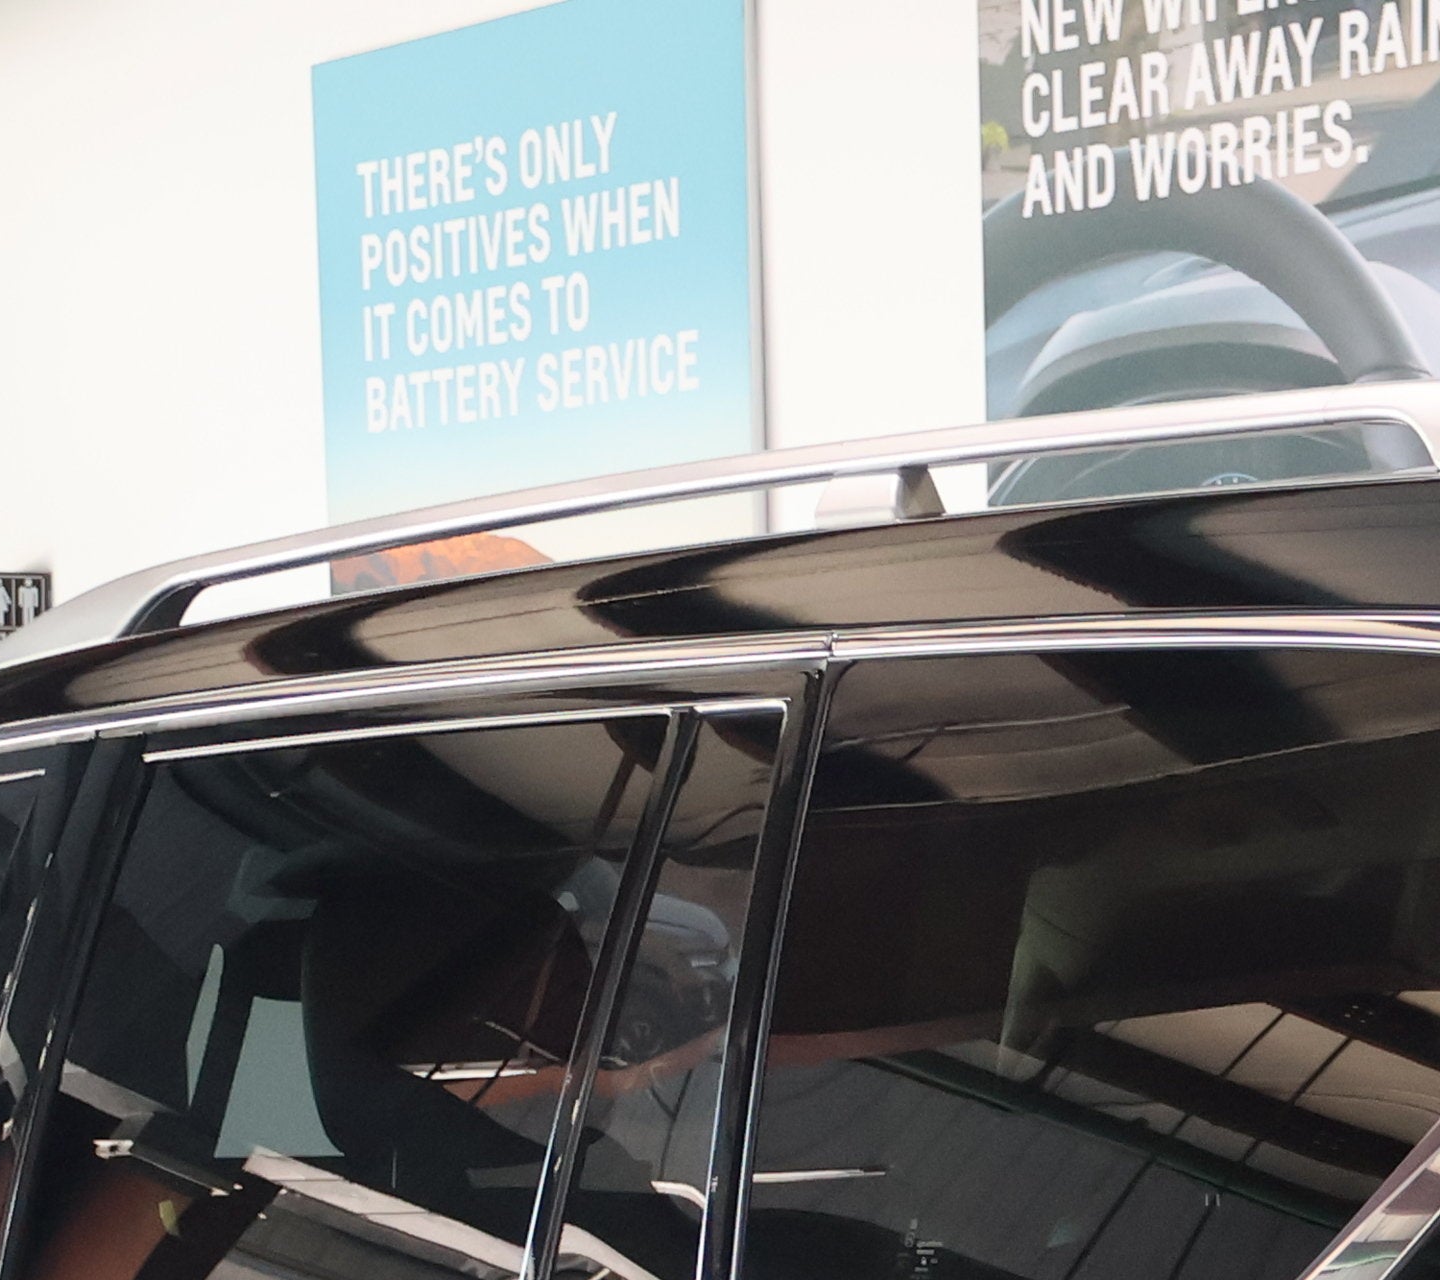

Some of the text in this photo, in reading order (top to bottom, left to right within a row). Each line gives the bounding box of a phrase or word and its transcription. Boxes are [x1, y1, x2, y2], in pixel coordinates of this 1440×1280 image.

[1021, 0, 1123, 58] NEW
[1022, 51, 1170, 138] CLEAR
[1184, 17, 1324, 110] AWAY
[356, 111, 617, 218] THERE'S ONLY
[1022, 100, 1370, 219] AND WORRIES.
[361, 177, 680, 291] POSITIVES WHEN
[363, 271, 590, 361] IT COMES TO
[366, 329, 700, 433] BATTERY SERVICE
